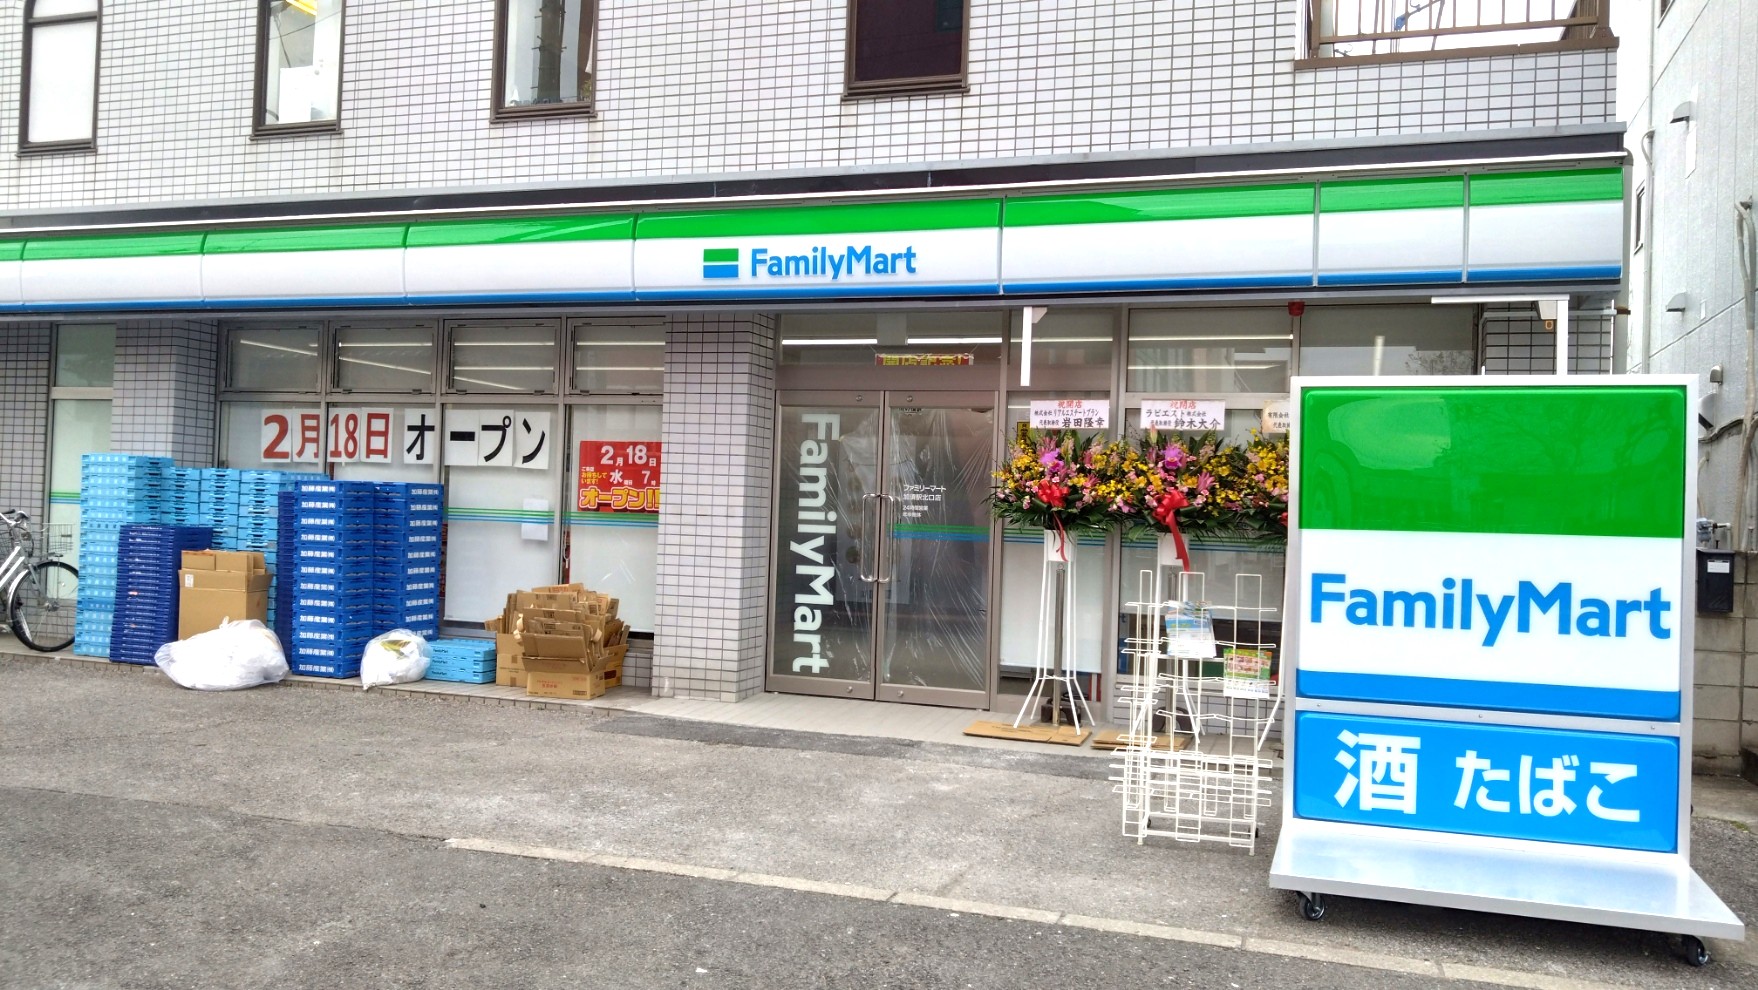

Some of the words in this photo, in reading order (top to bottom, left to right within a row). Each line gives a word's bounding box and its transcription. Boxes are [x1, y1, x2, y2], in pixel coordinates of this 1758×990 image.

[751, 245, 917, 280] FamilyMart
[262, 412, 390, 459] 2月18日
[406, 412, 546, 465] オープン
[600, 445, 657, 467] 2月18日
[903, 484, 946, 493] ファミリーマート
[789, 413, 841, 674] FamilyMart
[1310, 573, 1671, 647] FamilyMart
[1334, 729, 1421, 814] 酒
[1454, 750, 1640, 823] たばこ
